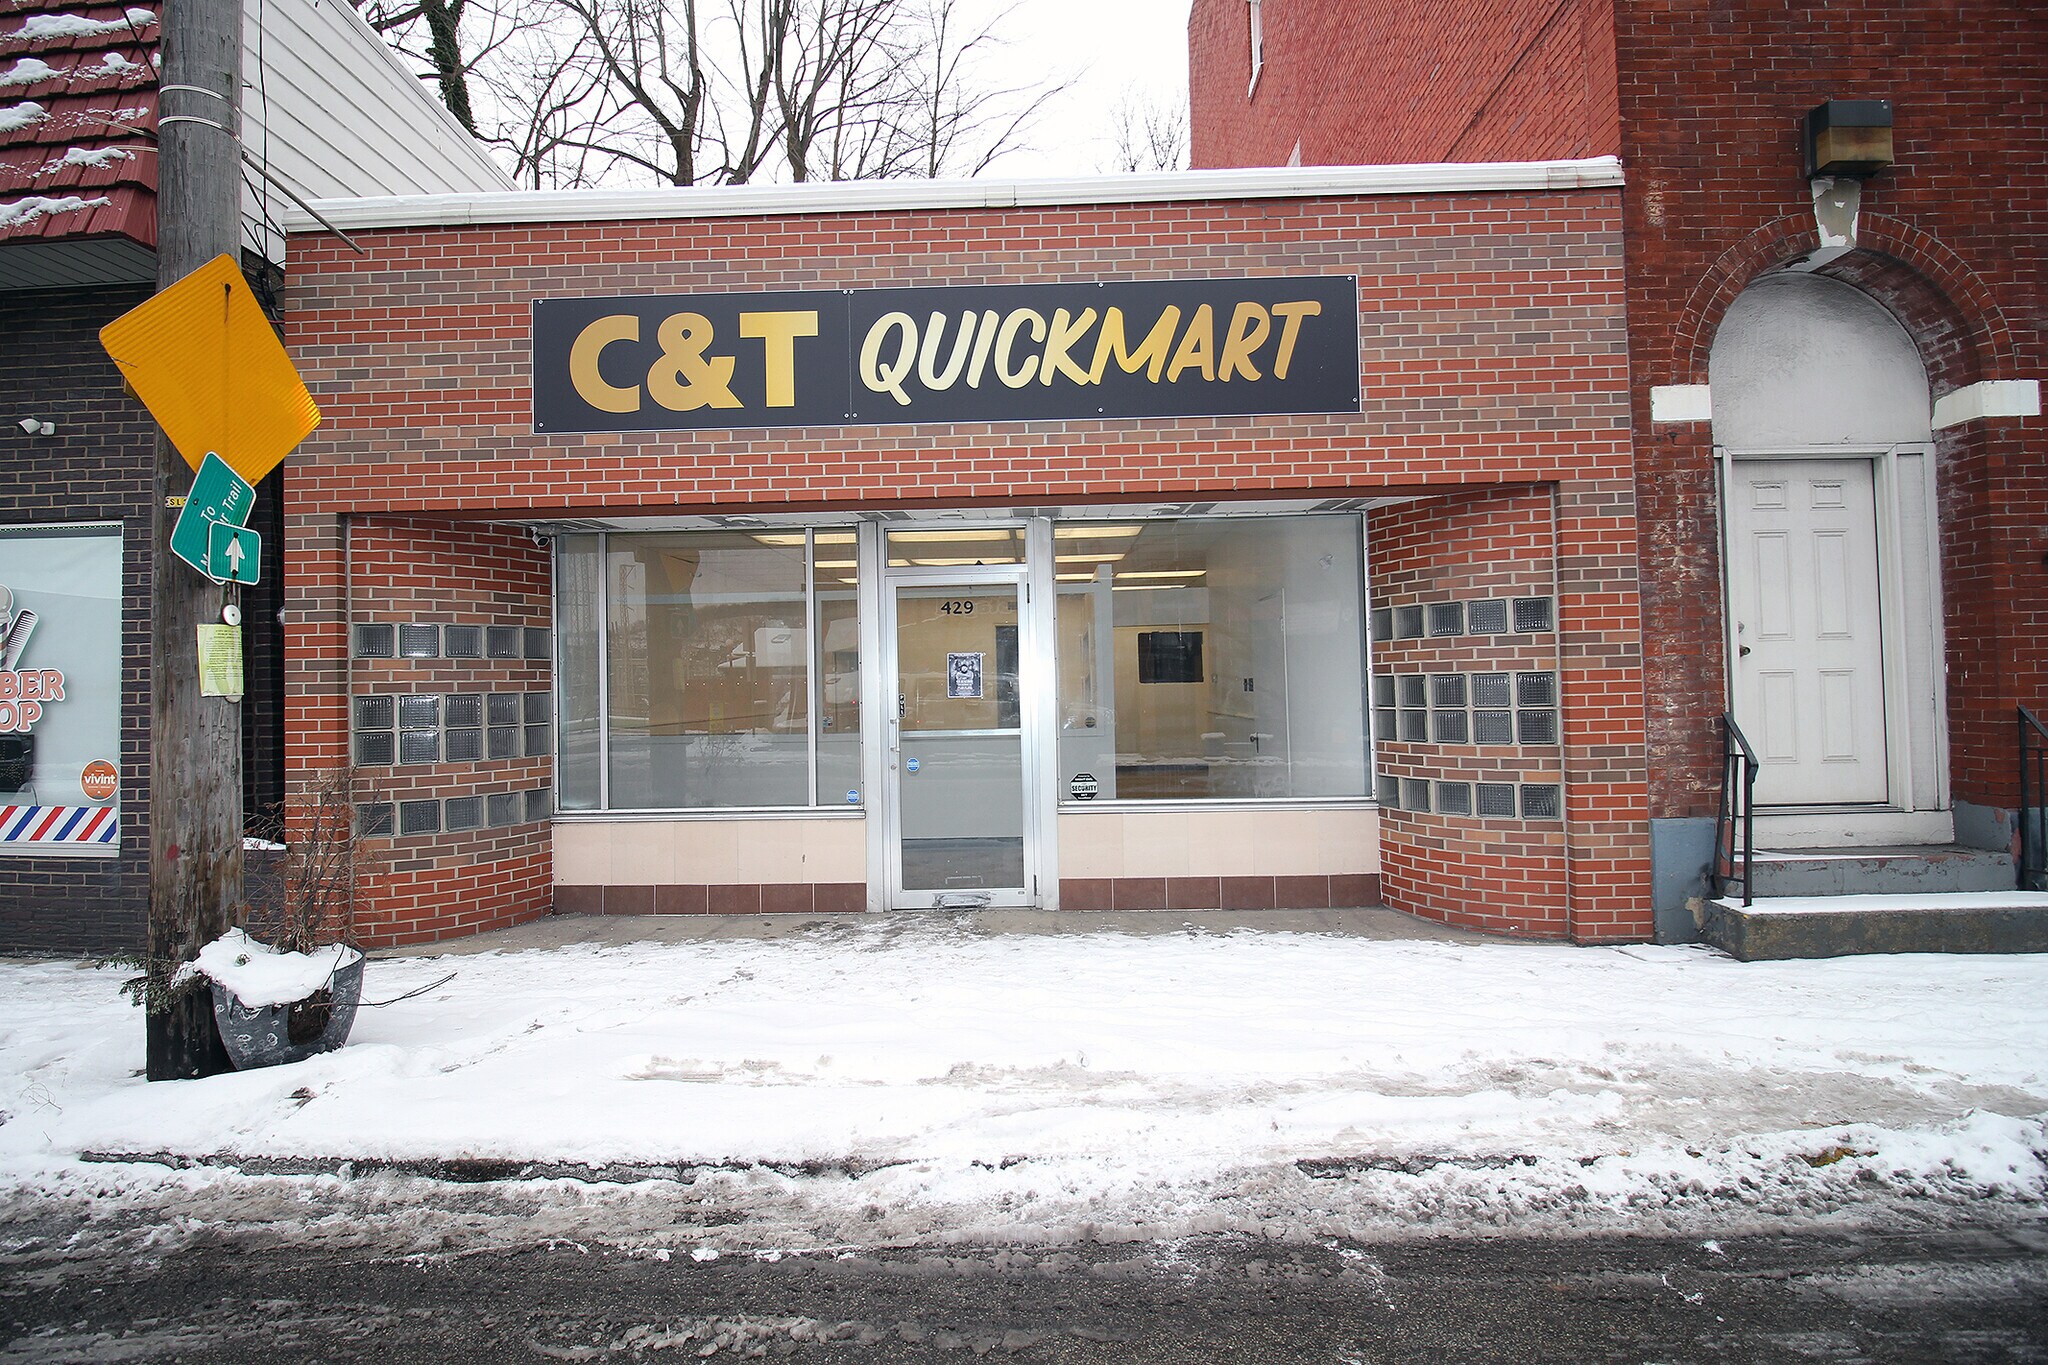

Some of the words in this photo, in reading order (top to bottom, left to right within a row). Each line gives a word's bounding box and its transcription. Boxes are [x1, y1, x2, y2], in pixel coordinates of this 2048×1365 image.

[569, 310, 819, 413] C&T
[859, 301, 1321, 406] QUICKMART
[222, 480, 242, 511] Trail
[200, 506, 216, 522] To
[940, 601, 974, 615] 429
[84, 773, 116, 785] vivint
[1071, 784, 1097, 792] SECURITY
